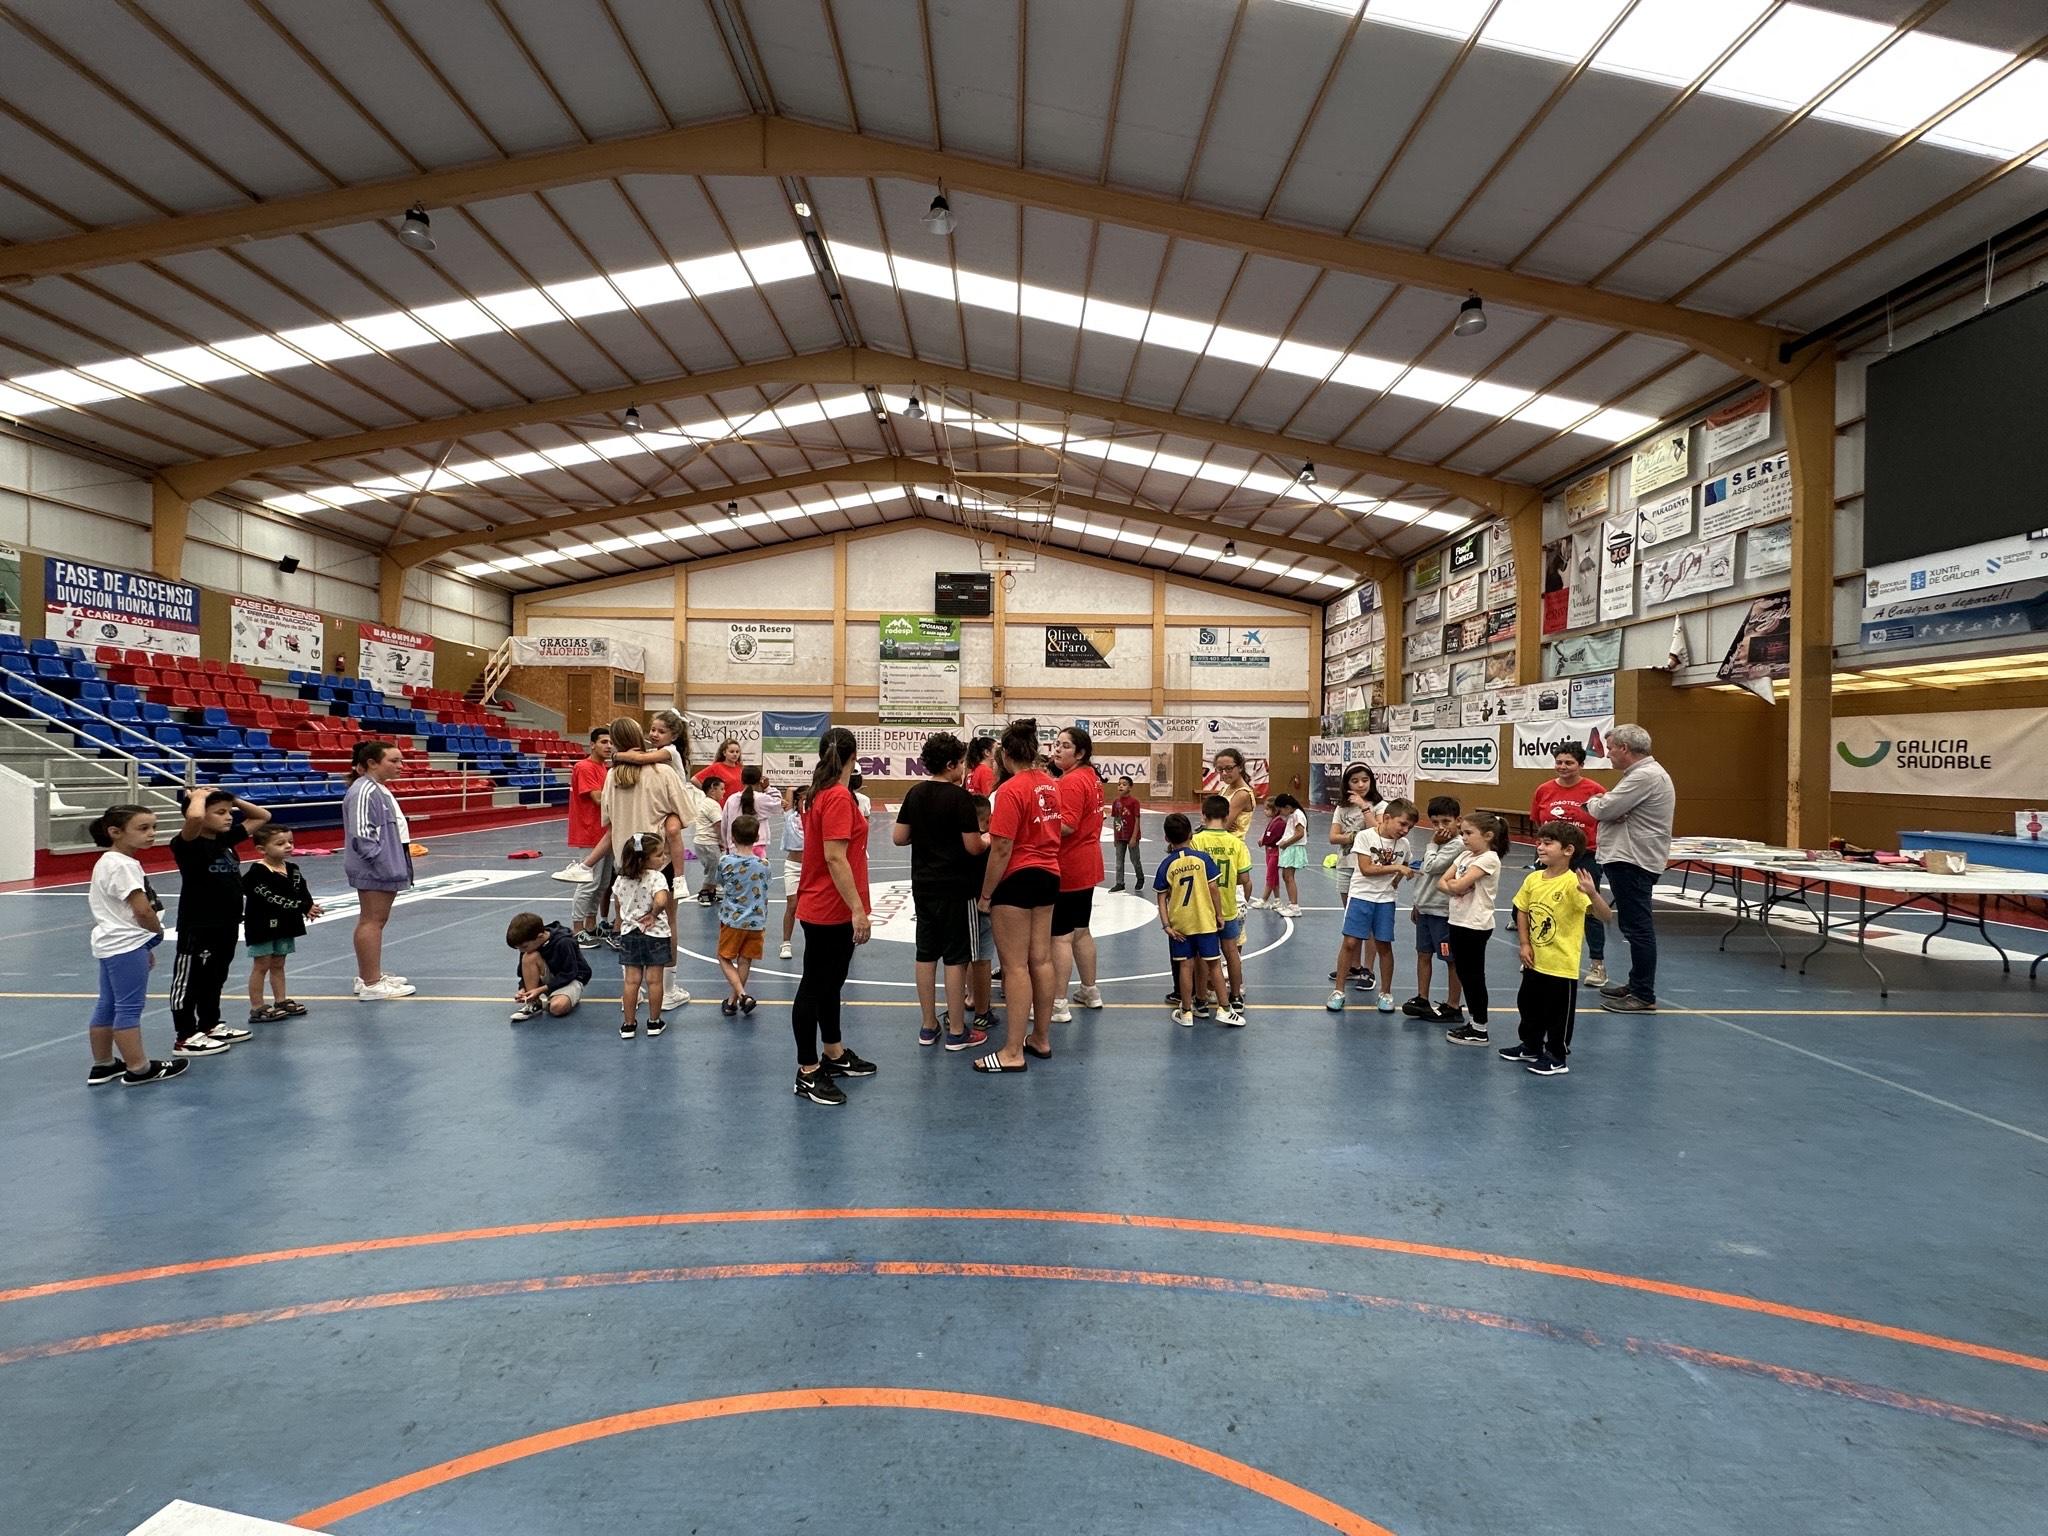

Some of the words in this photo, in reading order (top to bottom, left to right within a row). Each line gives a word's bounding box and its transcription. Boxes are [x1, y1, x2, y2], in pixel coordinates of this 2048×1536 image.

[1731, 477, 1769, 497] ASESORIA
[1778, 470, 1790, 480] XE
[1929, 565, 1960, 576] XUNTA
[1929, 575, 1941, 585] DE
[1942, 568, 1980, 583] GALICIA
[56, 562, 98, 590] FASE
[104, 571, 123, 594] DE
[127, 576, 193, 606] ASCENSO
[57, 584, 113, 609] DIVISIÓN
[117, 595, 155, 617] HONRA
[159, 604, 192, 623] PRATA
[234, 598, 261, 610] FASE
[262, 604, 277, 614] DE
[277, 607, 321, 622] ASCENSO
[1873, 607, 1885, 620] A
[1888, 604, 1930, 618] Cañiza
[1934, 602, 1946, 610] co
[1951, 587, 2015, 608] deporte!!
[75, 607, 84, 616] A
[86, 609, 129, 623] CAÑIZA
[131, 616, 154, 627] 2021
[246, 610, 280, 621] PRIMERA
[282, 616, 317, 628] NACIONAL
[731, 624, 743, 632] Os
[759, 624, 792, 633] Resero
[1047, 629, 1094, 641] Oliveira
[540, 638, 588, 648] GRACIAS
[1092, 721, 1120, 729] XUNTA
[1105, 728, 1136, 737] GALICIA
[1390, 735, 1412, 743] DEPORTE
[1312, 743, 1340, 756] ABANCA
[1352, 741, 1366, 749] XUNTA
[1390, 743, 1410, 751] GALEGO
[1897, 739, 1968, 753] GALICIA
[1897, 755, 1992, 769] SAUDABLE
[1094, 763, 1146, 776] BANCA
[1375, 771, 1408, 785] PUTACIÓN
[1171, 864, 1200, 877] RONALDO
[1179, 875, 1194, 907] 7
